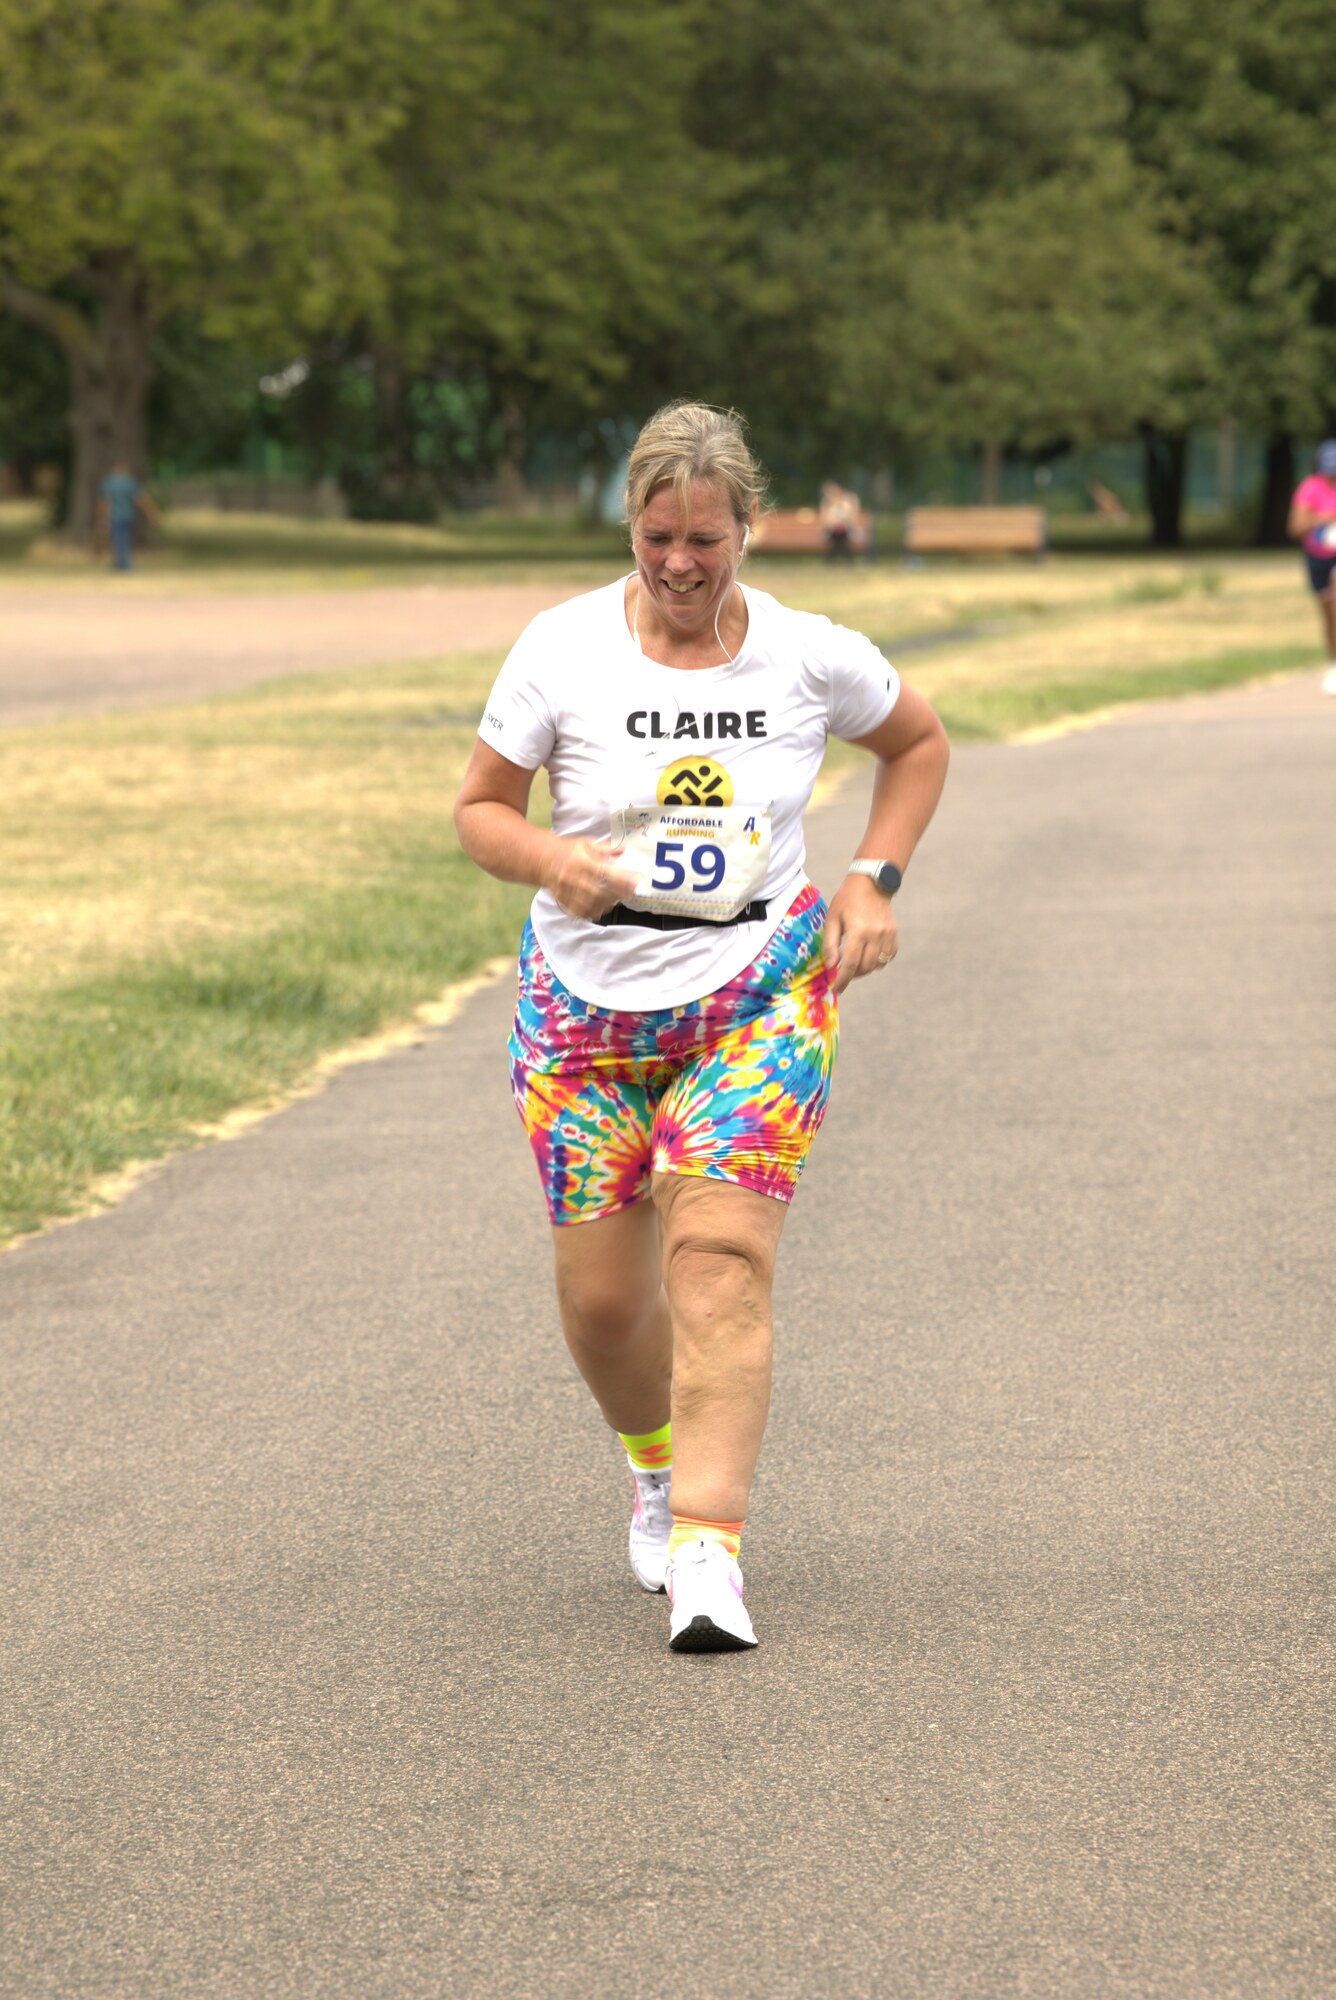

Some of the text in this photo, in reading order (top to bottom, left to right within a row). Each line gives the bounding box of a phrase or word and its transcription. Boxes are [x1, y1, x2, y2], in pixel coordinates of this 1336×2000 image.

[626, 710, 767, 739] CLAIRE
[660, 816, 723, 828] AFFORDABLE
[666, 828, 715, 838] RUNNING
[651, 841, 726, 893] 59
